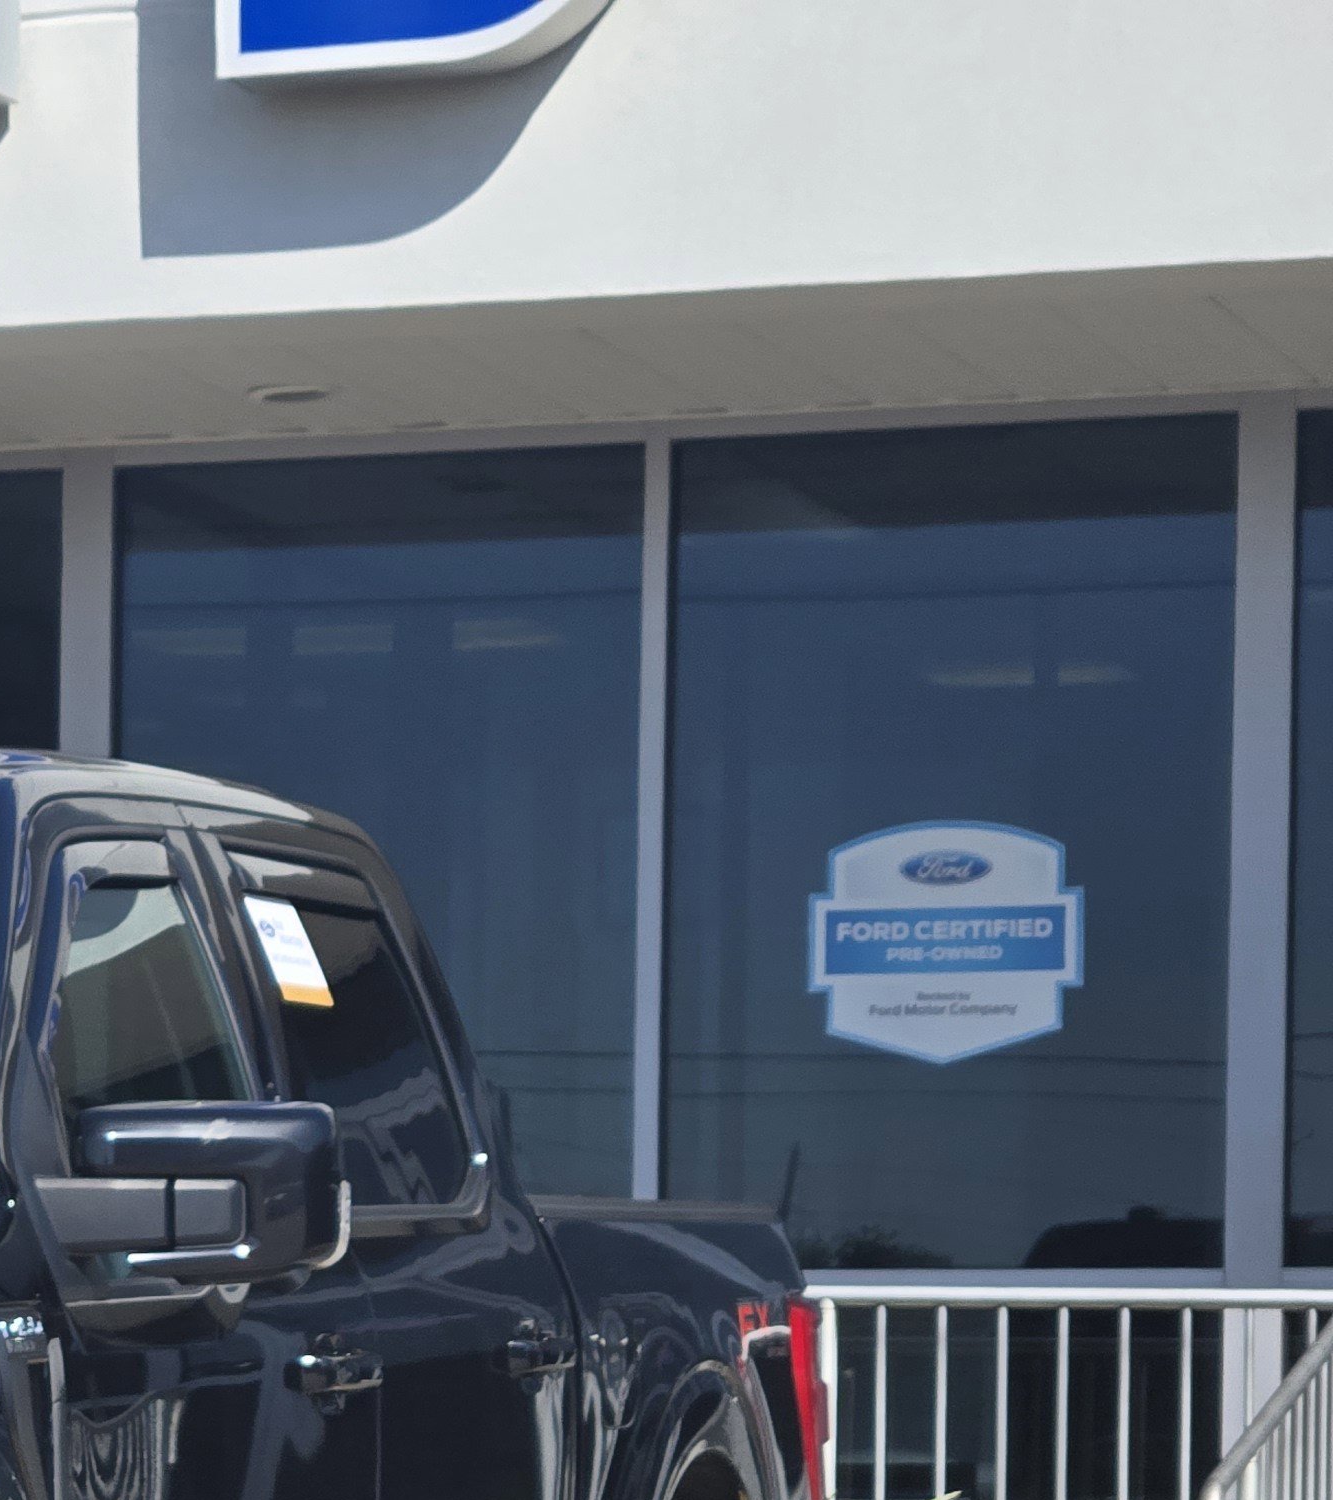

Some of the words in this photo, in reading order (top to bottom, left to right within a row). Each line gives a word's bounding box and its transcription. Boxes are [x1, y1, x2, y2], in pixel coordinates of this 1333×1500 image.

[836, 920, 910, 942] FORD
[914, 917, 1054, 942] CERTIFIED
[886, 944, 1004, 962] PRE-OWNED
[869, 1004, 902, 1016] Ford
[904, 1003, 947, 1016] Motor
[949, 1002, 1018, 1017] Company
